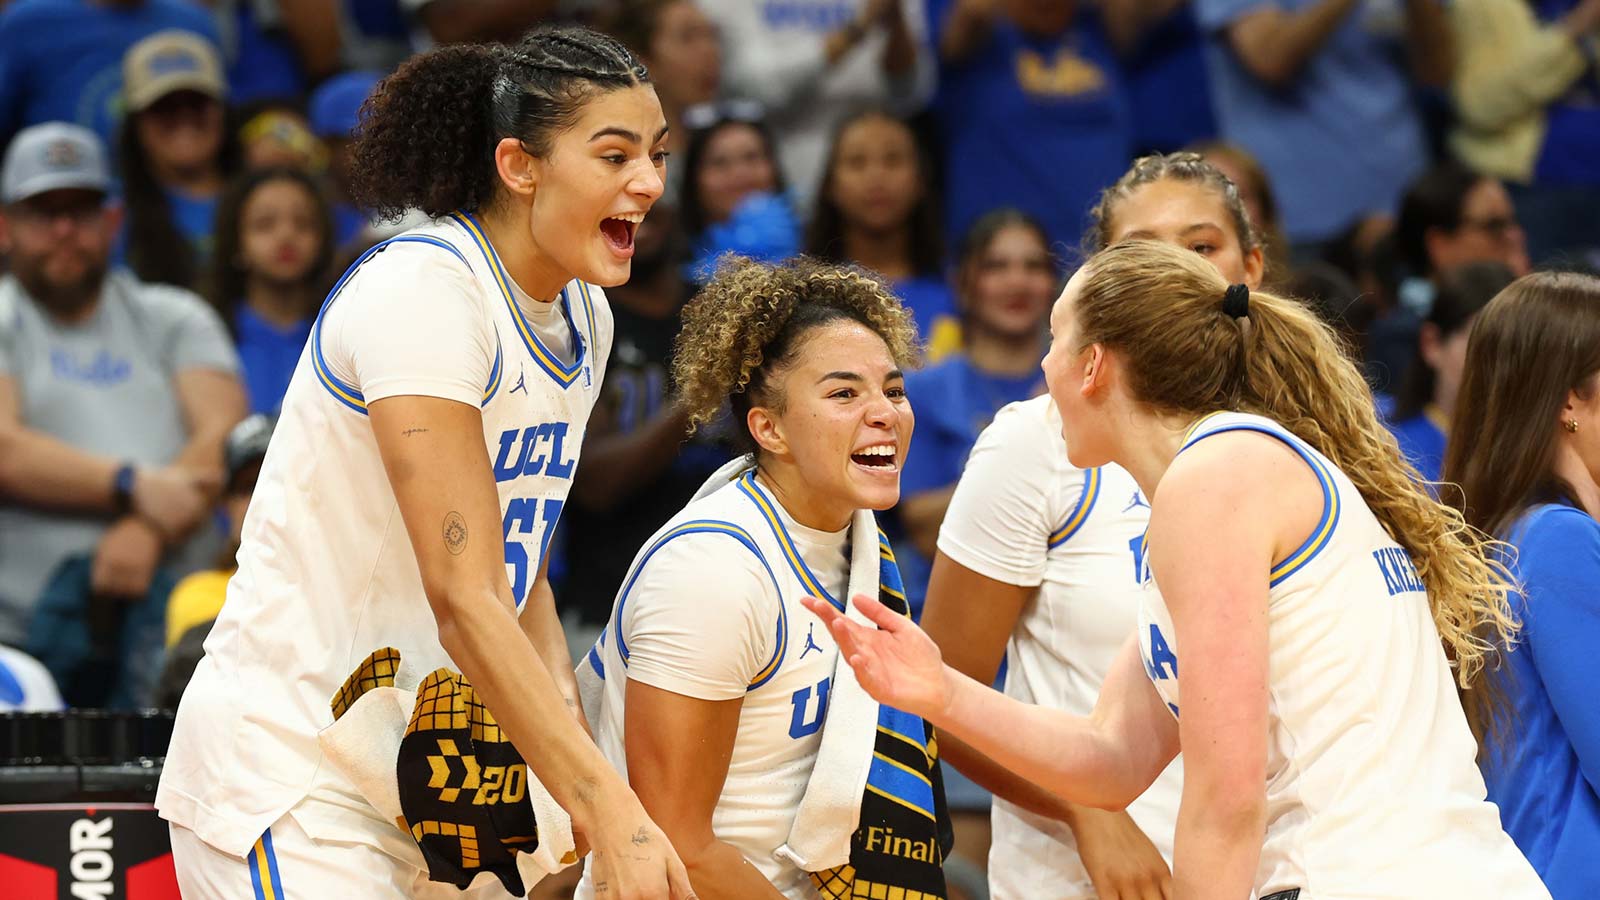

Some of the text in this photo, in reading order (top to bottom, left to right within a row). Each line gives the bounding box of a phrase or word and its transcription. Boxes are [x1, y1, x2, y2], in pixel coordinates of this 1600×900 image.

[493, 421, 575, 483] UCL
[788, 676, 830, 740] U
[864, 825, 936, 865] Final
